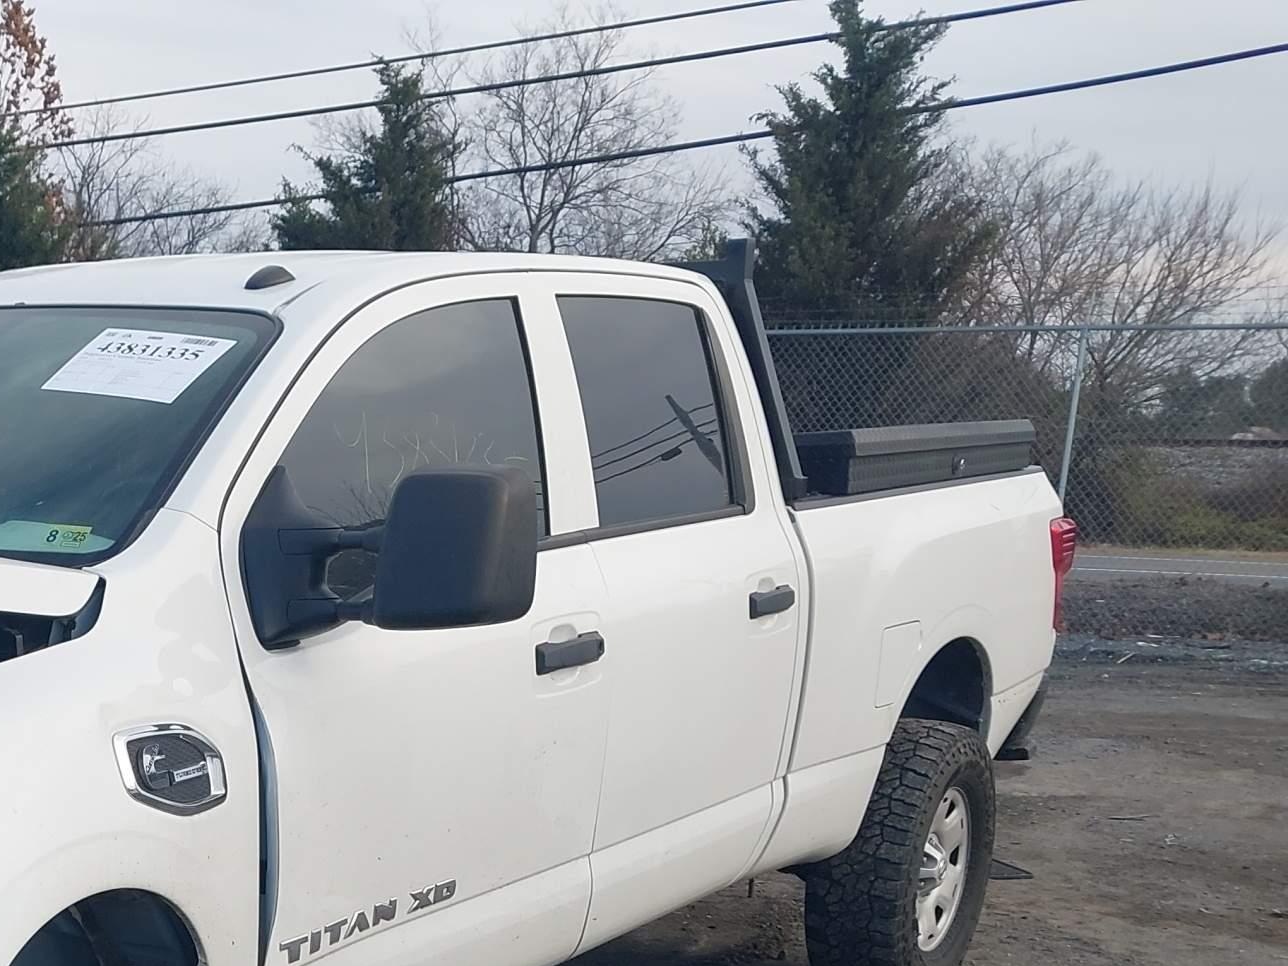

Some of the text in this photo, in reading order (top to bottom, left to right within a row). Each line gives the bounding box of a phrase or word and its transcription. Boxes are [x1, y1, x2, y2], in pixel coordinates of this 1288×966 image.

[97, 341, 205, 361] 43831335
[46, 529, 59, 543] 8
[279, 878, 457, 964] TITAN XD
